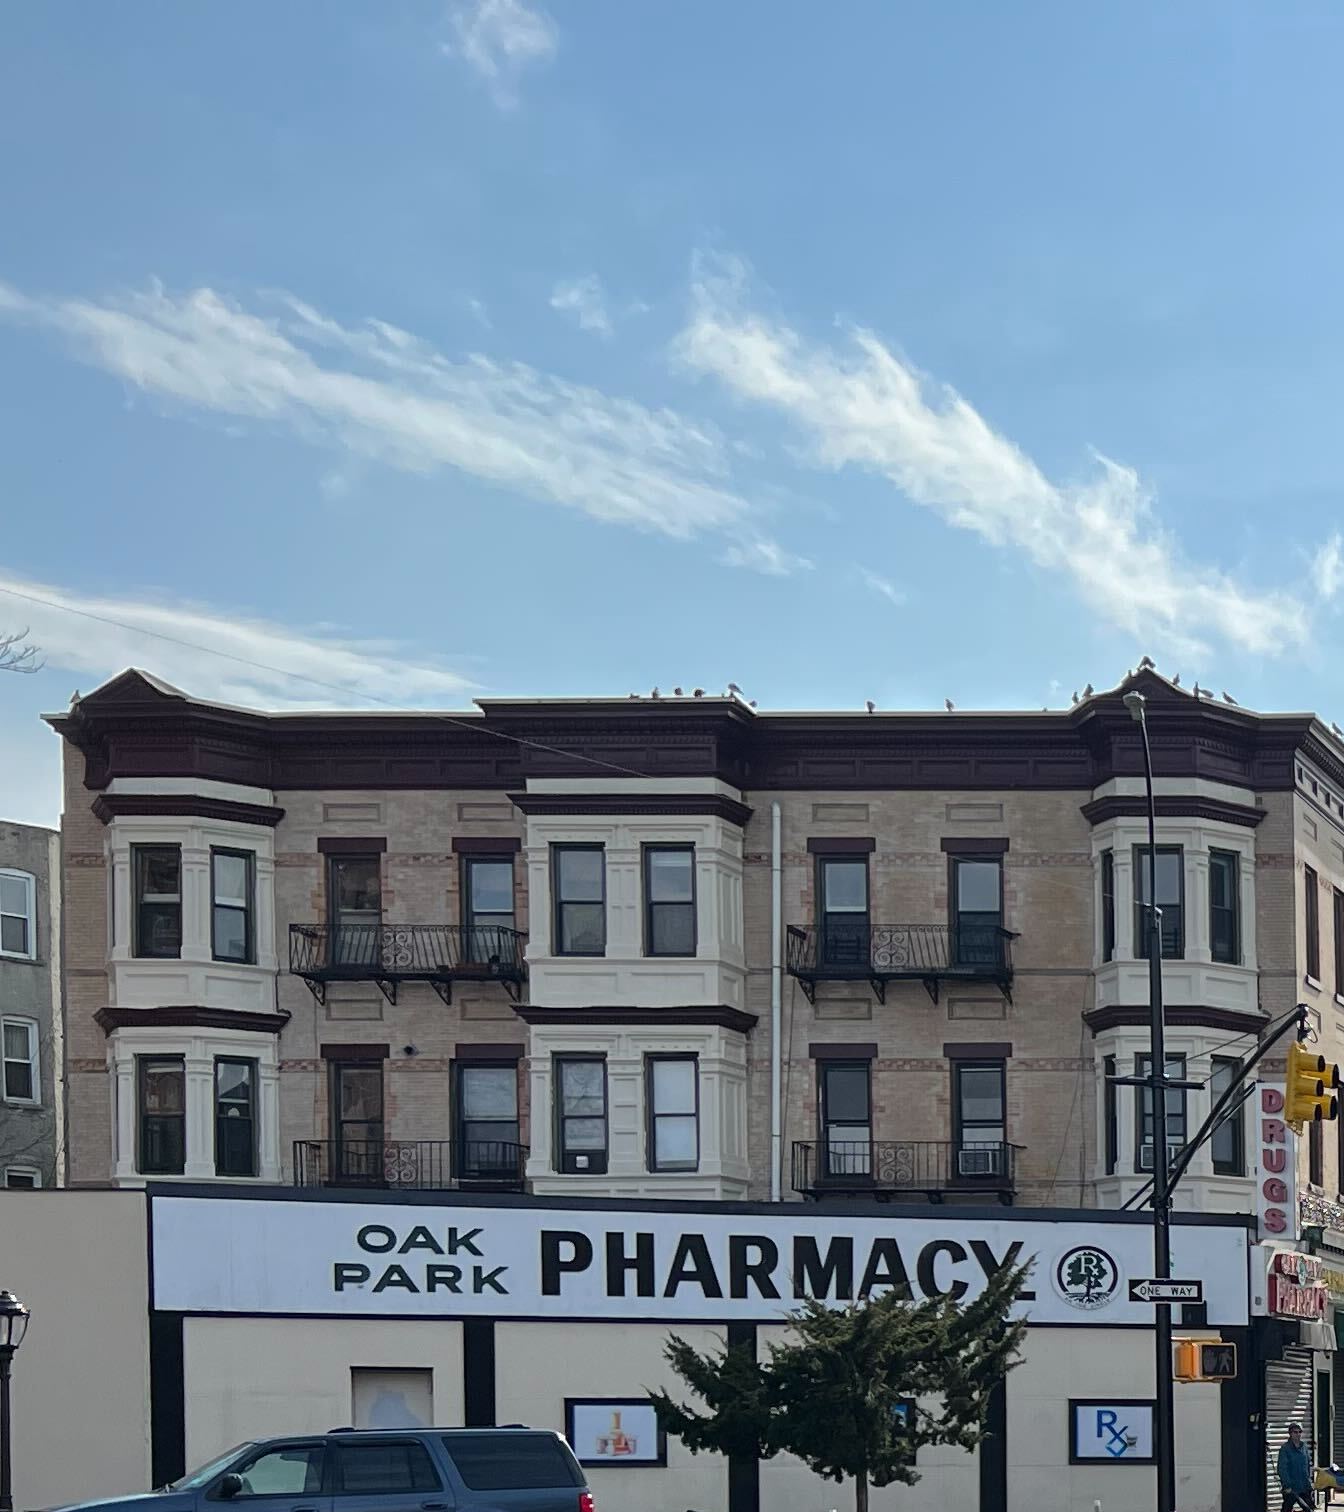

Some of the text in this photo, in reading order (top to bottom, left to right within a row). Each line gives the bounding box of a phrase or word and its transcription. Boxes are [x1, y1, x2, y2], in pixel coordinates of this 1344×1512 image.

[1261, 1088, 1288, 1234] DRUGS
[356, 1223, 485, 1257] OAK
[333, 1262, 510, 1296] PARK
[540, 1229, 1026, 1301] PHARMACY
[1140, 1286, 1193, 1296] ONE WAY
